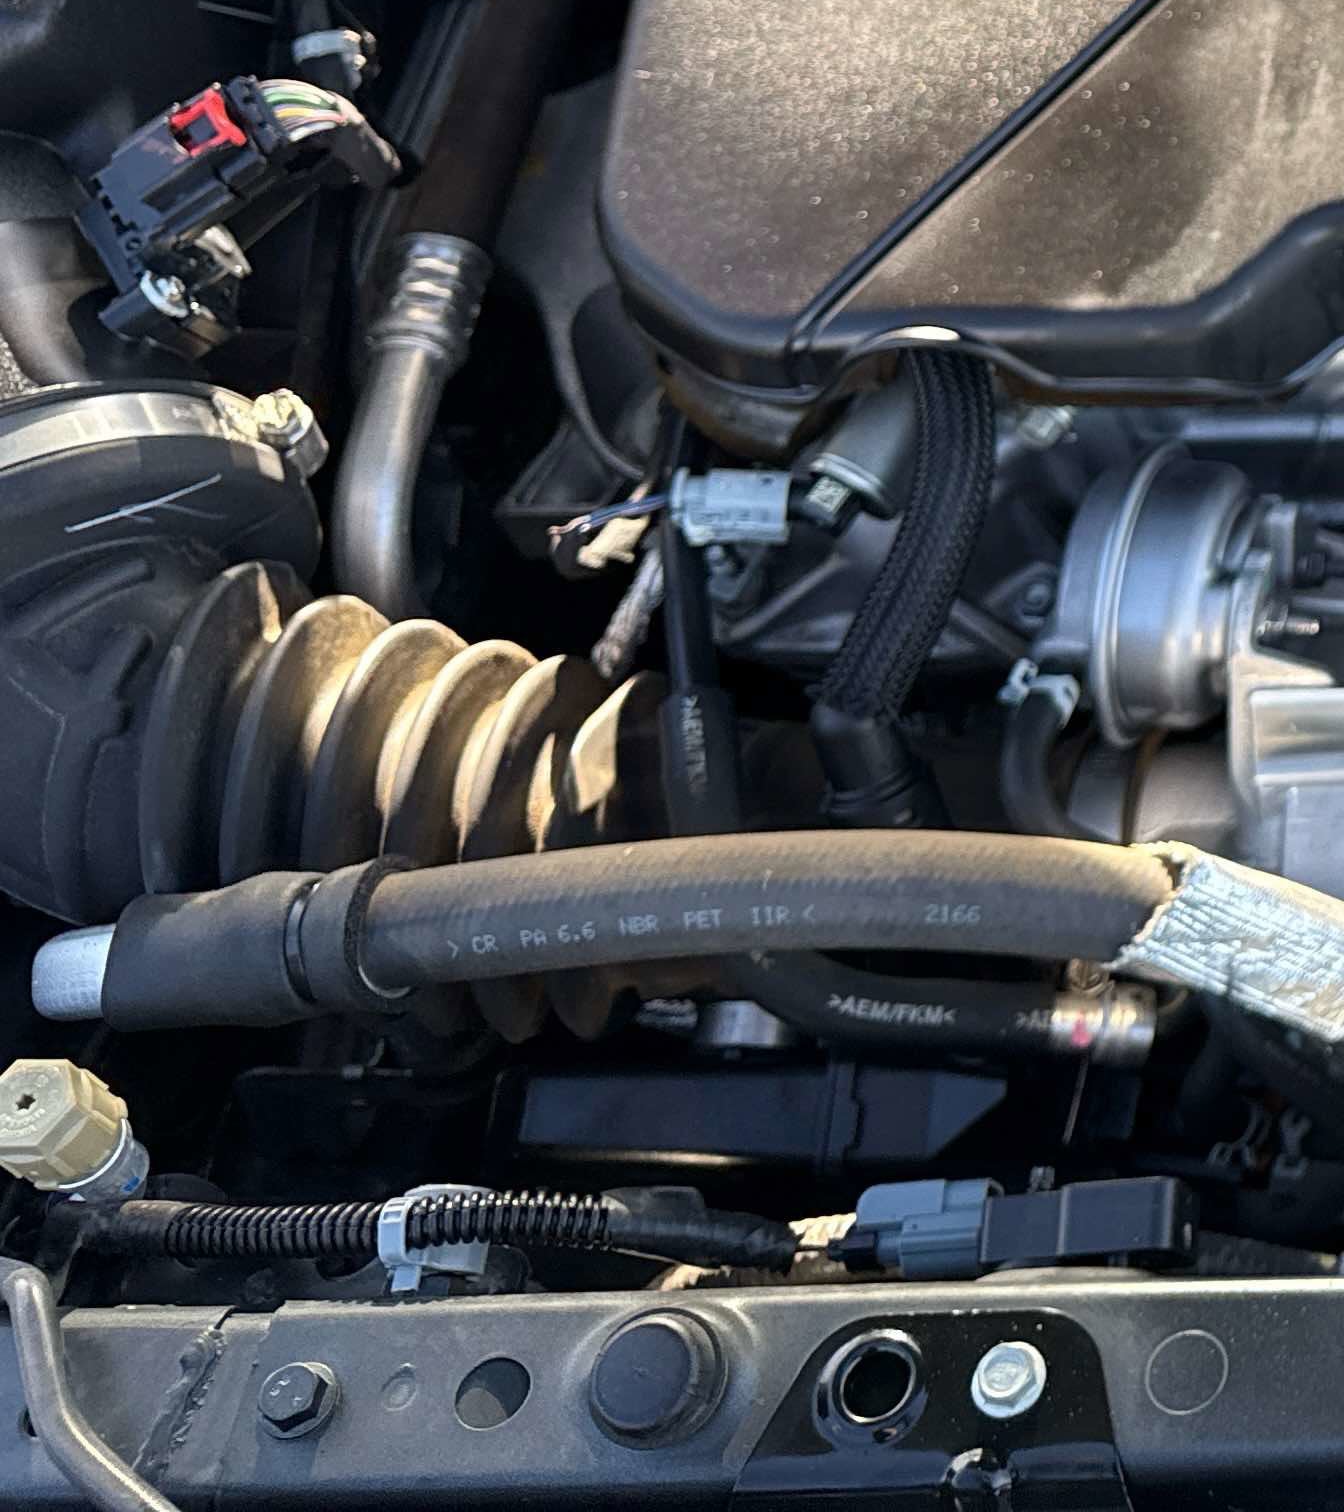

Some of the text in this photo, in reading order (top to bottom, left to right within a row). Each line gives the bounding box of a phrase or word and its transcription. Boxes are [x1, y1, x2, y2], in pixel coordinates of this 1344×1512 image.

[471, 934, 498, 954] CR
[519, 929, 547, 949] PA
[557, 921, 596, 944] 6.6
[683, 908, 722, 931] PET
[924, 903, 981, 925] 2166
